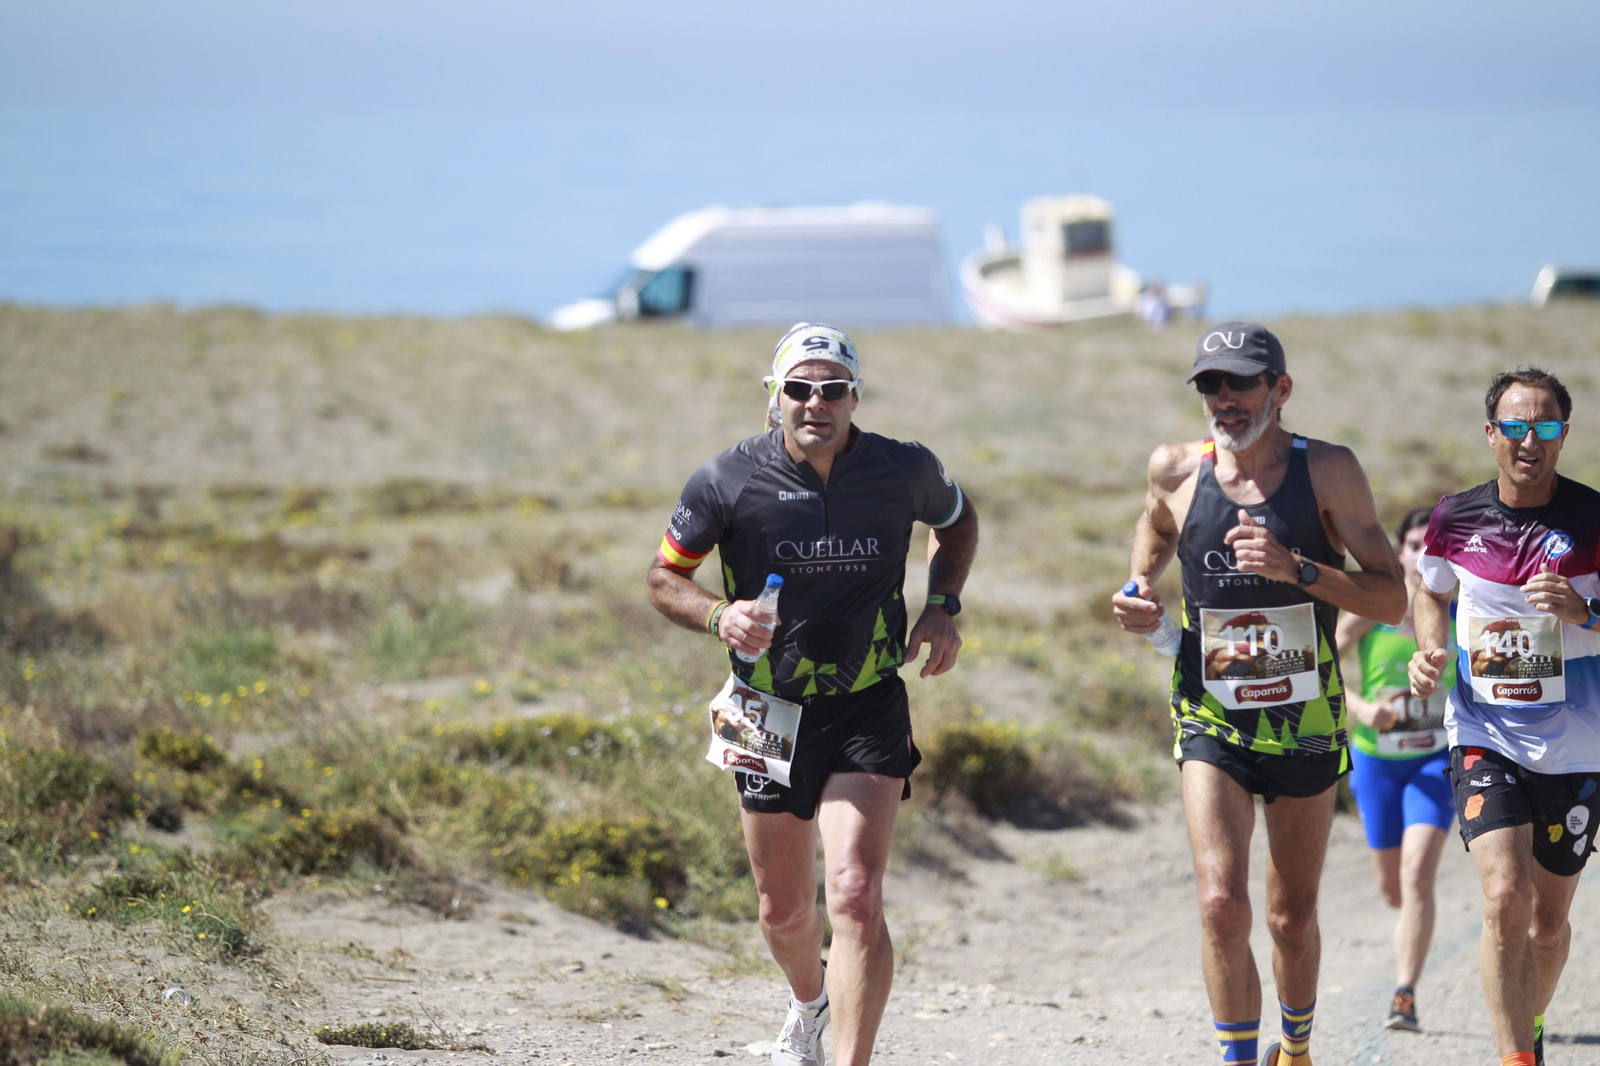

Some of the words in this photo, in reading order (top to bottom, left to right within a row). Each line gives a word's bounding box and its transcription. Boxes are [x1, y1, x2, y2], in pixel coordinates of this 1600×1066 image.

[1203, 331, 1246, 352] CU
[775, 537, 881, 560] CUELLAR
[790, 565, 833, 574] STONE
[838, 564, 867, 572] 1958
[1218, 578, 1260, 587] STONE
[1219, 624, 1284, 657] 110
[1480, 630, 1535, 657] 140
[1519, 655, 1553, 664] XIII
